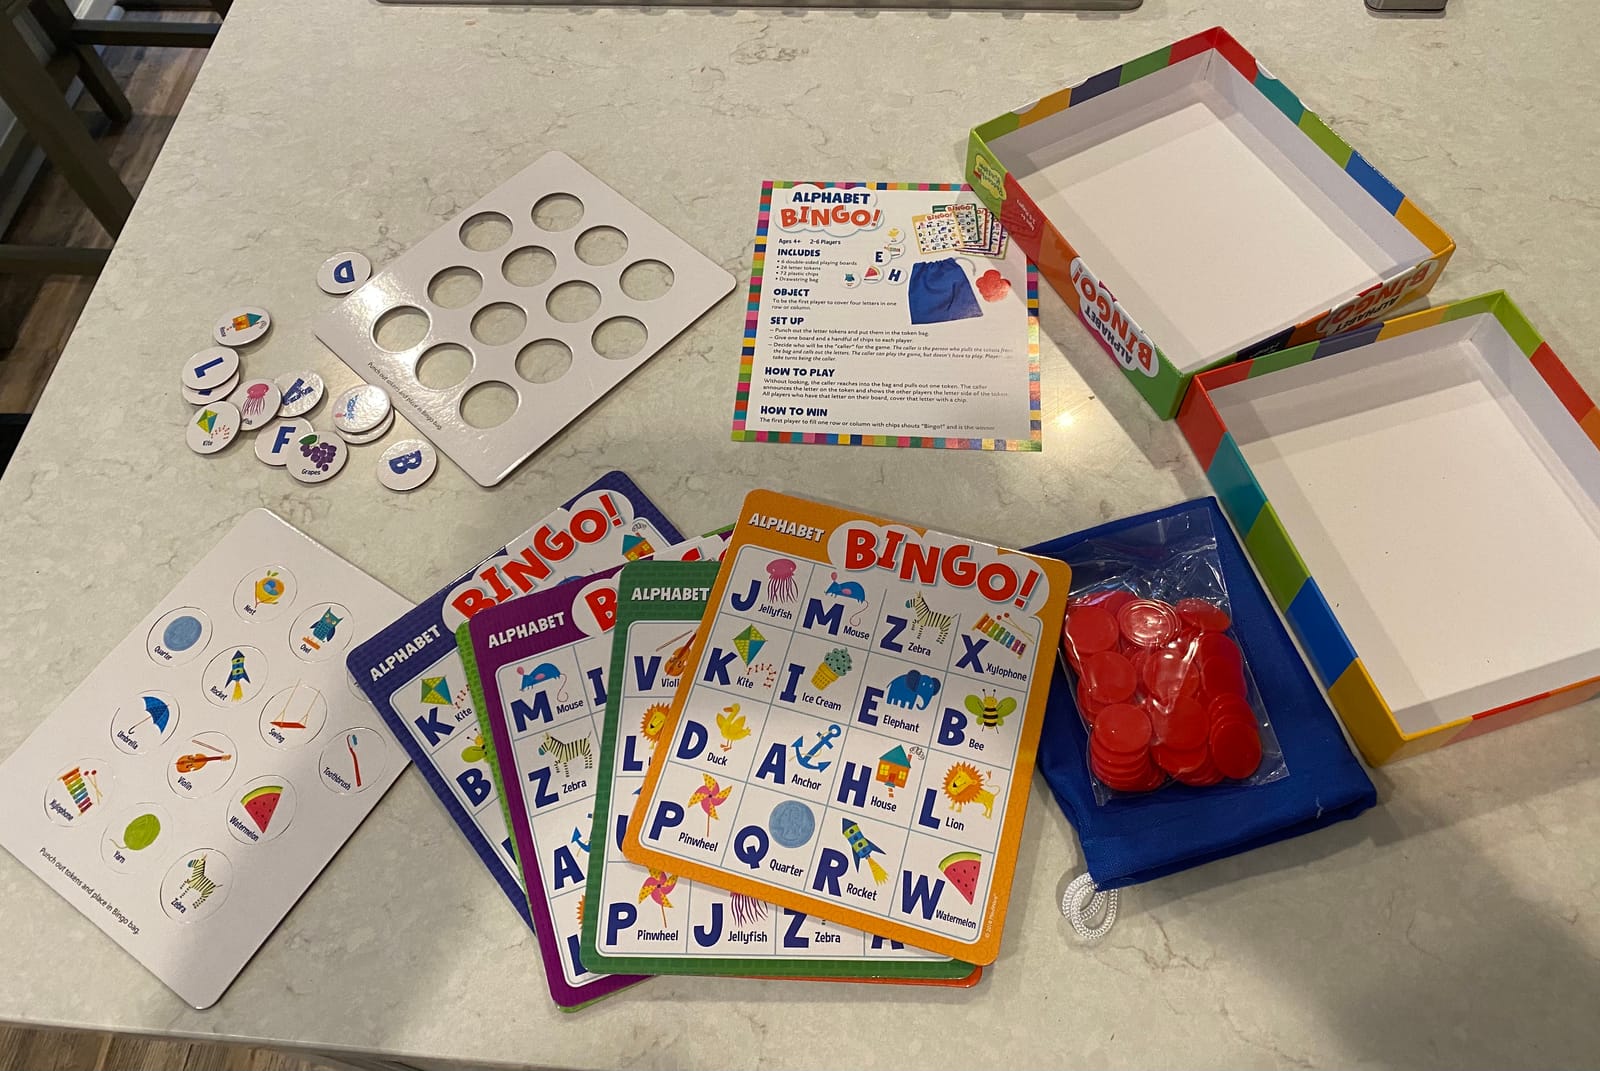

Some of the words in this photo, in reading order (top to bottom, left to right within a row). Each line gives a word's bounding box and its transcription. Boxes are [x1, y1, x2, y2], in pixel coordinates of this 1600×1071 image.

[792, 192, 870, 204] ALPHABET
[781, 205, 880, 228] BINGO!
[778, 249, 820, 257] INCLUDES
[875, 251, 883, 262] E
[334, 260, 355, 283] D
[888, 268, 901, 282] H
[773, 288, 810, 297] OBJECT
[770, 316, 788, 325] SET
[1072, 267, 1153, 371] BINGO!
[1084, 305, 1133, 364] ALPHABET
[194, 357, 224, 378] L
[765, 366, 790, 376] HOW
[792, 368, 807, 376] TO
[810, 368, 835, 377] PLAY
[760, 406, 786, 415] HOW
[789, 407, 804, 416] TO
[806, 408, 828, 417] WIN
[272, 426, 296, 454] F
[301, 468, 321, 476] Grapes
[388, 450, 422, 475] B
[747, 513, 826, 543] ALPHABET
[451, 494, 622, 619] BINGO!
[845, 528, 1040, 610] BINGO!
[632, 587, 710, 601] ALPHABET
[731, 580, 762, 612] J
[243, 604, 257, 616] Nest
[758, 603, 793, 620] Jellyfish
[802, 599, 844, 636] M
[488, 612, 565, 649] ALPHABET
[844, 626, 870, 640] Mouse
[879, 615, 908, 653] Z
[154, 645, 173, 660] Quarter
[369, 625, 443, 682] ALPHABET
[908, 642, 932, 656] Zebra
[956, 634, 990, 673] X
[634, 656, 662, 691] V
[703, 648, 738, 686] K
[986, 663, 1027, 682] Xylophone
[210, 685, 228, 701] Rocket
[587, 667, 608, 706] I
[662, 678, 680, 687] Violi
[736, 675, 754, 689] Kite
[780, 663, 805, 703] I
[510, 690, 554, 733] M
[556, 699, 584, 714] Mouse
[802, 692, 815, 703] Ice
[817, 696, 842, 711] Cream
[857, 686, 885, 726] E
[455, 707, 472, 723] Kite
[883, 715, 920, 733] Elephant
[268, 728, 285, 744] Swing
[414, 706, 455, 747] K
[938, 708, 967, 746] B
[116, 730, 138, 751] Umbrella
[676, 720, 708, 760] D
[968, 738, 985, 752] Bee
[623, 735, 643, 771] L
[706, 752, 728, 767] Duck
[755, 743, 788, 785] A
[177, 776, 193, 791] Violin
[323, 767, 351, 790] Toothbrush
[456, 767, 492, 807] B
[528, 766, 559, 808] Z
[561, 778, 587, 794] Zebra
[791, 774, 821, 791] Anchor
[837, 761, 872, 808] H
[49, 799, 74, 821] Xylophone
[870, 795, 897, 813] House
[918, 788, 940, 829] L
[229, 816, 259, 842] Watermelon
[649, 800, 684, 841] P
[945, 818, 965, 832] Lion
[678, 831, 719, 853] Pinwheel
[733, 825, 769, 870] Q
[113, 850, 126, 864] Yarn
[554, 845, 586, 890] A
[769, 858, 804, 878] Quarter
[812, 848, 849, 898] R
[40, 847, 56, 864] Punch
[55, 862, 65, 872] out
[65, 869, 82, 886] tokens
[81, 882, 95, 895] and
[90, 892, 107, 907] place
[106, 902, 113, 912] in
[112, 908, 128, 925] Bingo
[846, 883, 877, 901] Rocket
[902, 870, 945, 920] W
[170, 898, 186, 914] Zebra
[606, 903, 638, 946] P
[694, 903, 723, 947] J
[784, 908, 809, 948] Z
[936, 909, 976, 929] Watermelon
[637, 929, 679, 941] Pinwheel
[728, 931, 768, 944] Jellyfish
[814, 932, 841, 943] Zebra
